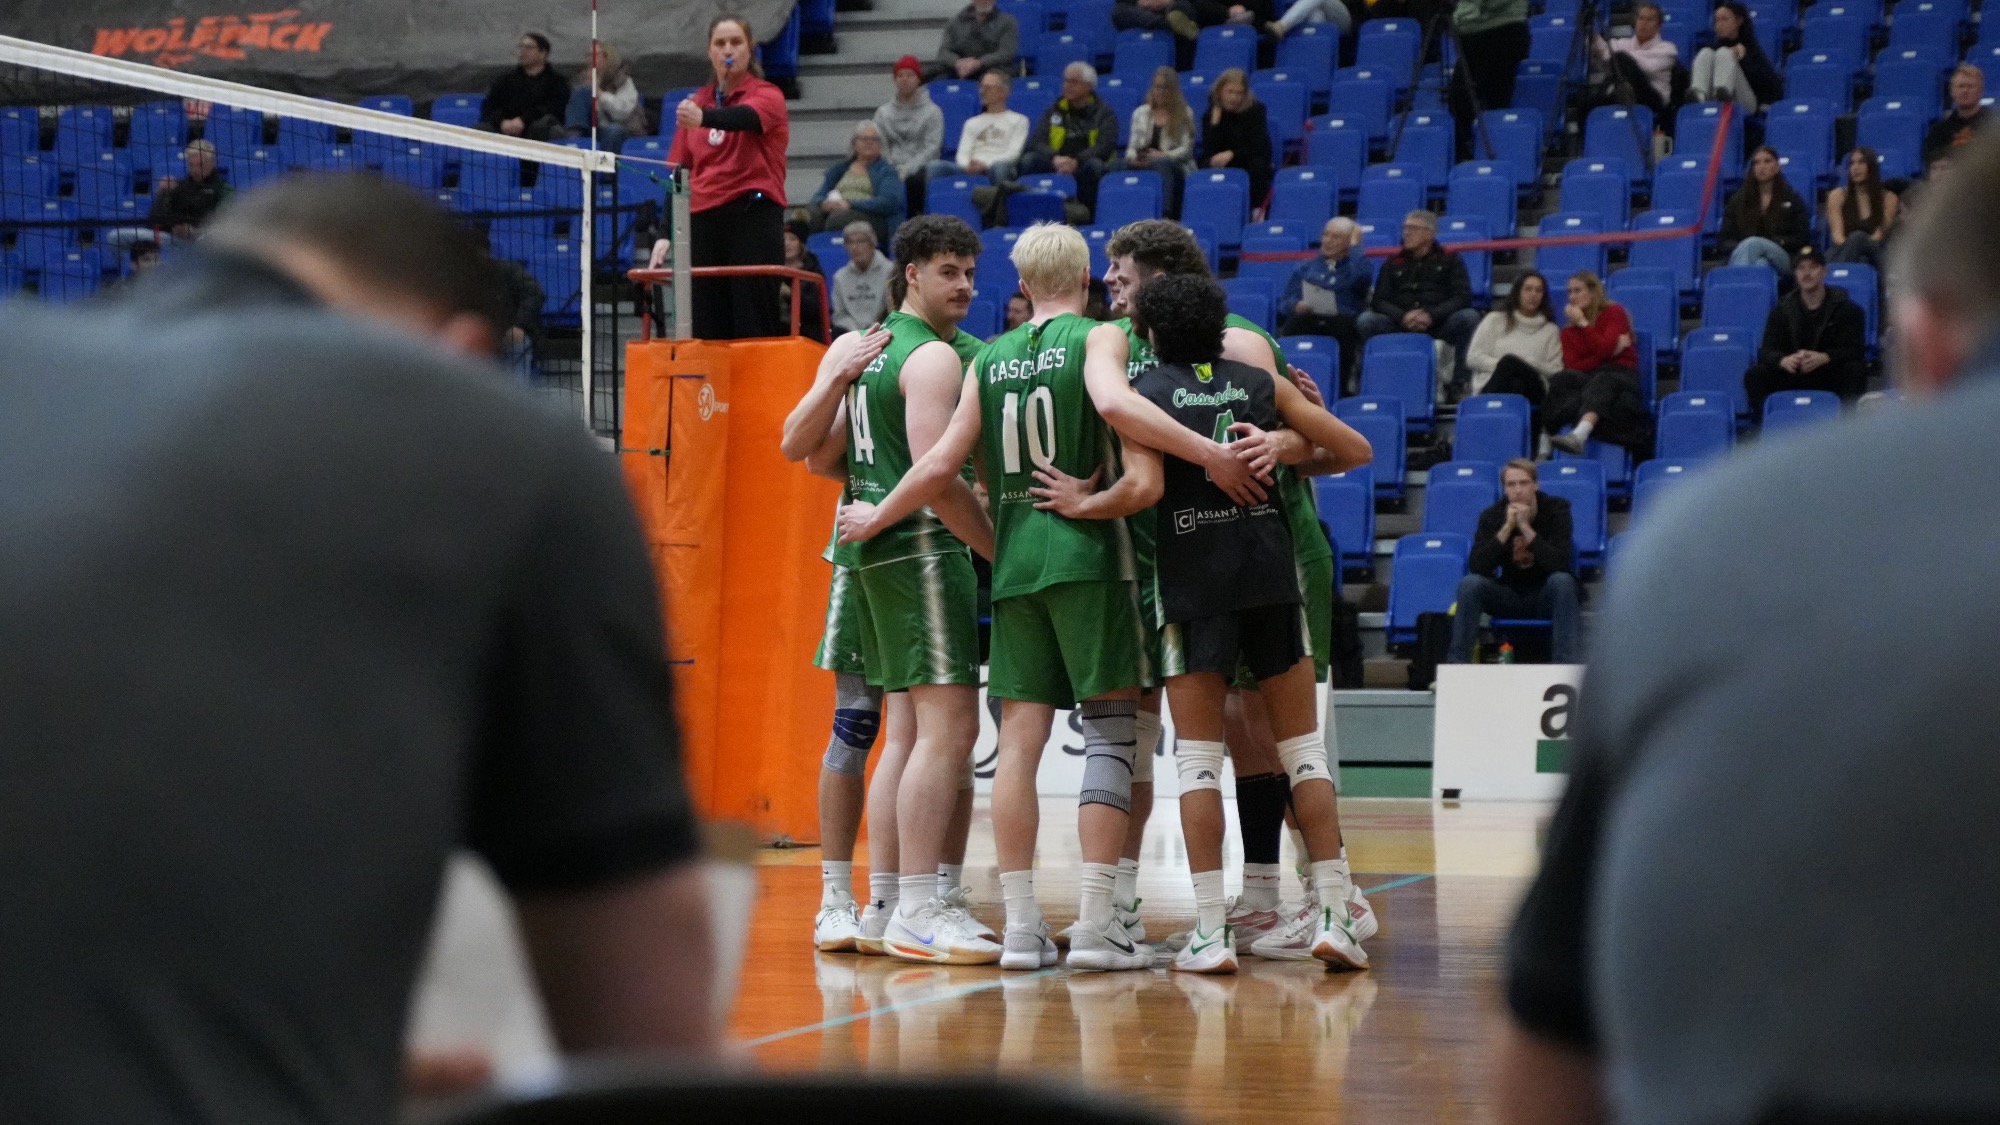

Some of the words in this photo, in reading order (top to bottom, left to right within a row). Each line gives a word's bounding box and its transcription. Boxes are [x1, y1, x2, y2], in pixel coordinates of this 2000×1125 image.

[91, 9, 334, 65] WOLFPACK
[989, 347, 1067, 385] CASCADES
[1172, 380, 1249, 408] Cascades
[847, 383, 874, 465] 14
[1002, 386, 1056, 474] 10
